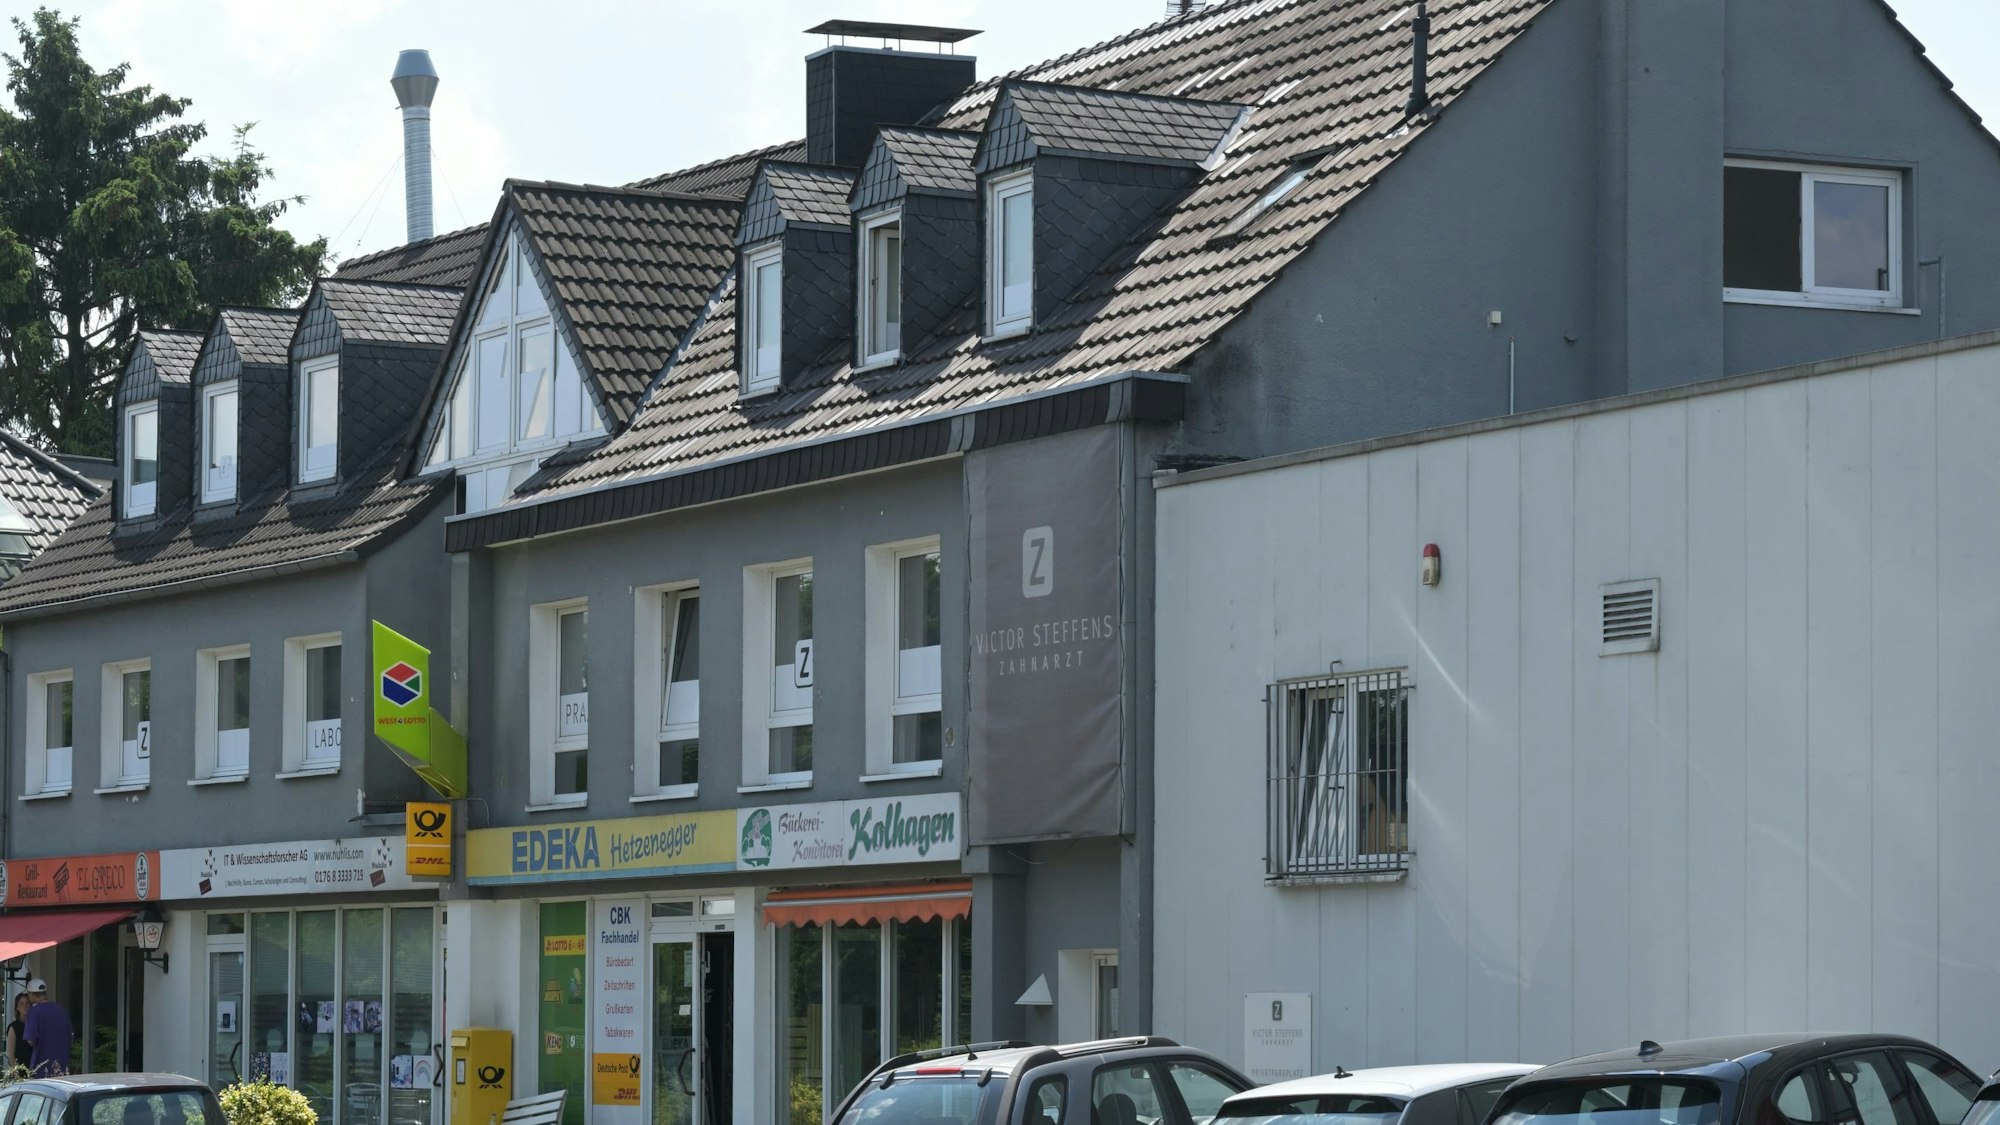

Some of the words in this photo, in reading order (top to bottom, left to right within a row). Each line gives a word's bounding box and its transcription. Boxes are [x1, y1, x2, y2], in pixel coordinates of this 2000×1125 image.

[1029, 537, 1046, 586] Z
[976, 627, 1025, 655] VICTOR
[1033, 614, 1113, 647] STEFFENS
[799, 646, 810, 678] Z
[999, 650, 1084, 675] ZAHNARZT
[377, 717, 397, 725] WEST
[403, 717, 426, 725] LOTTO
[565, 703, 588, 726] PRA
[141, 727, 148, 751] Z
[778, 811, 825, 836] Bäckerei-
[848, 800, 955, 862] Kolhagen
[314, 846, 364, 862] www.nuhlis.com
[512, 825, 601, 873] EDEKA
[610, 821, 697, 868] Hetzenegger
[791, 838, 844, 863] Konditorei
[223, 853, 229, 867] IT
[230, 854, 235, 866] &
[236, 850, 298, 866] Wissenschaftsforscher
[300, 849, 308, 861] AG
[415, 856, 445, 865] DHL
[24, 863, 40, 882] Grill-
[77, 867, 90, 891] EL
[92, 864, 126, 898] GRECO
[314, 870, 331, 883] 0176
[332, 870, 337, 882] 8
[337, 869, 352, 882] 3333
[353, 868, 364, 881] 719
[17, 883, 48, 899] Restaurant
[609, 906, 631, 925] CBK
[601, 930, 640, 946] Fachhandel
[605, 955, 634, 968] Bürobedarf
[603, 979, 636, 991] Zeitschriften
[605, 1003, 634, 1015] Grußkarten
[604, 1027, 635, 1039] Tabakwaren
[597, 1063, 617, 1074] Deutsche
[618, 1062, 629, 1073] Post
